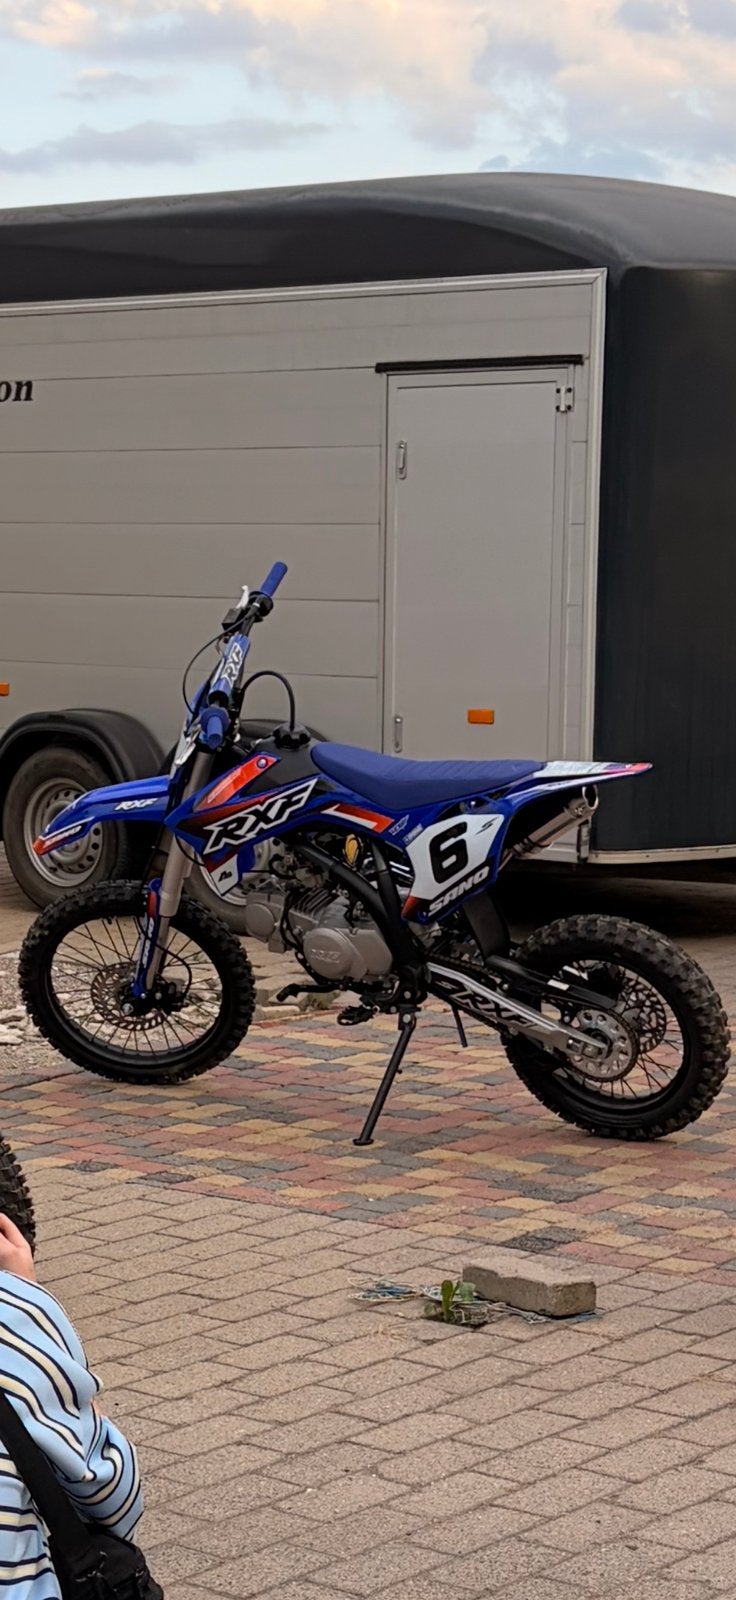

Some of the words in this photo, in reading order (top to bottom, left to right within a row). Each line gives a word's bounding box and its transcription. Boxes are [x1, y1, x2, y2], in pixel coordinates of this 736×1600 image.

[222, 642, 243, 688] RXF
[114, 797, 158, 811] RXF
[203, 778, 318, 855] RXF
[429, 821, 468, 884] 6
[428, 866, 490, 917] SANO
[451, 990, 541, 1028] RXF
